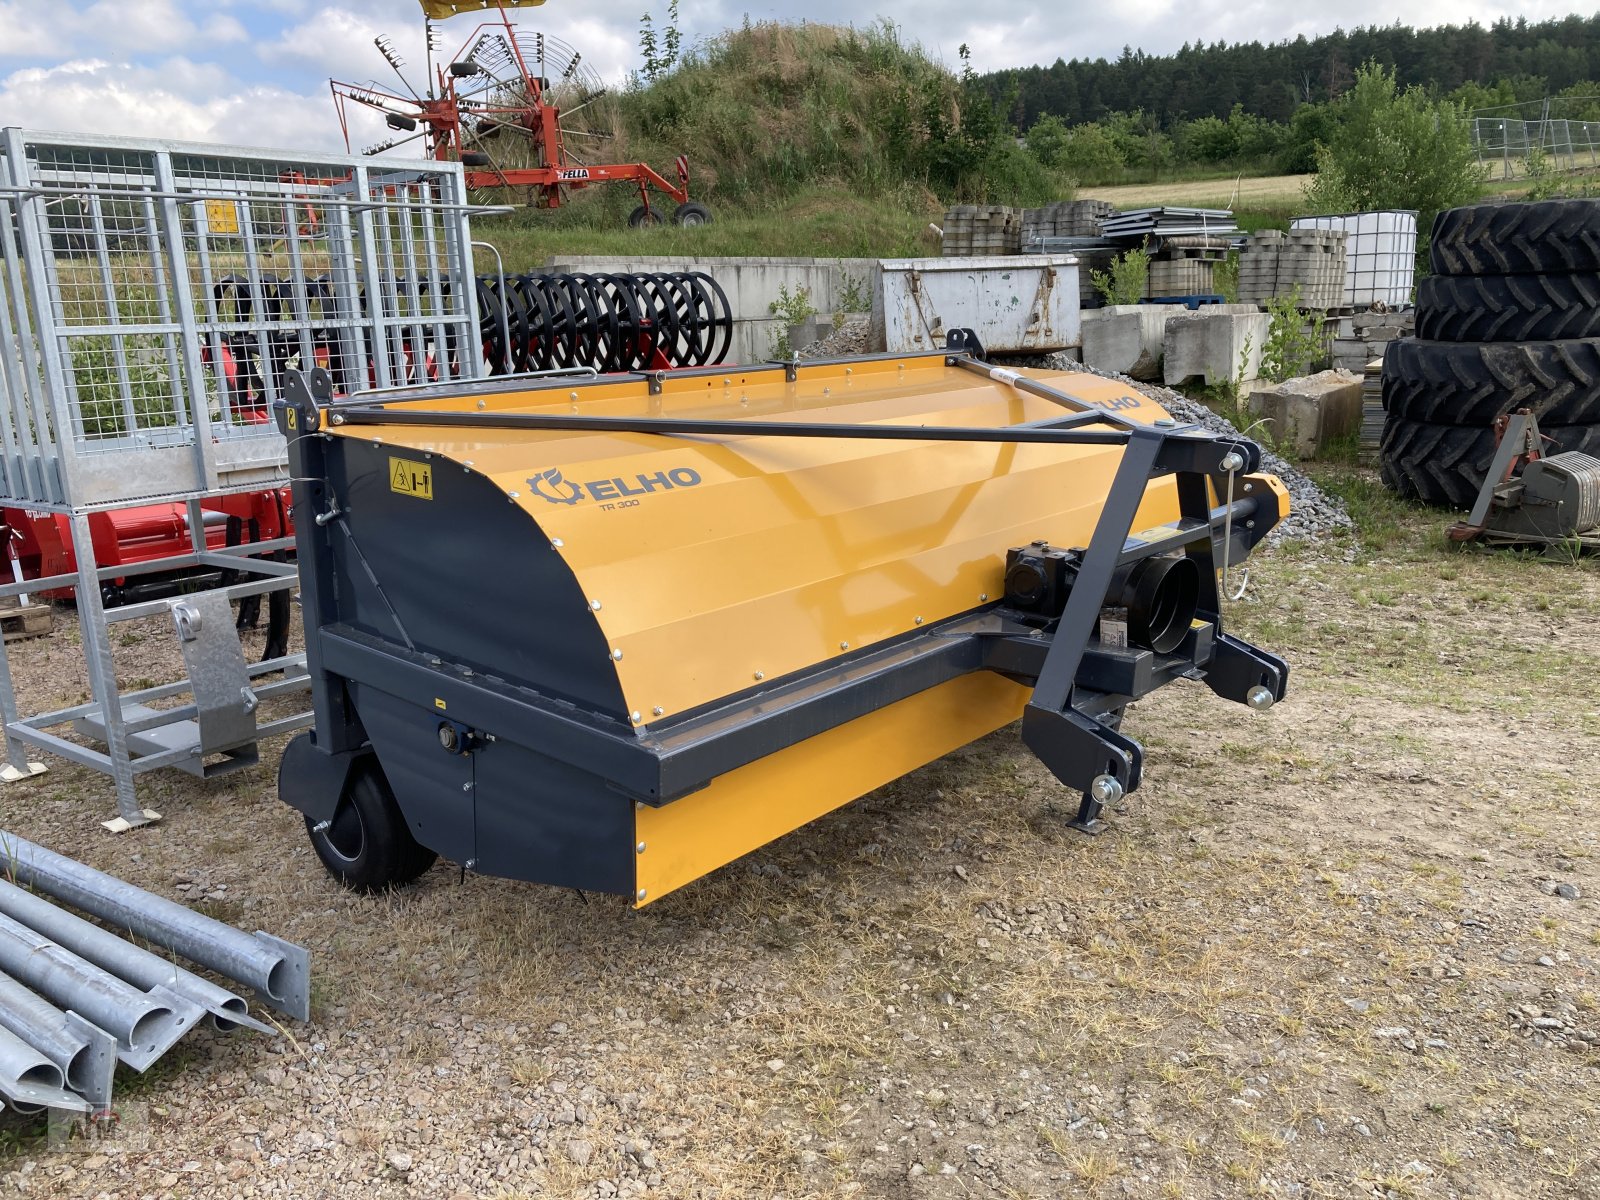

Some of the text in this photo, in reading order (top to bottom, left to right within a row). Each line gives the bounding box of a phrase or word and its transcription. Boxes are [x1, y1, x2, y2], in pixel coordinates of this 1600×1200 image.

[562, 169, 588, 178] FELLA
[1094, 396, 1141, 411] LHO
[584, 467, 702, 502] ELHO
[599, 499, 641, 512] TR 300
